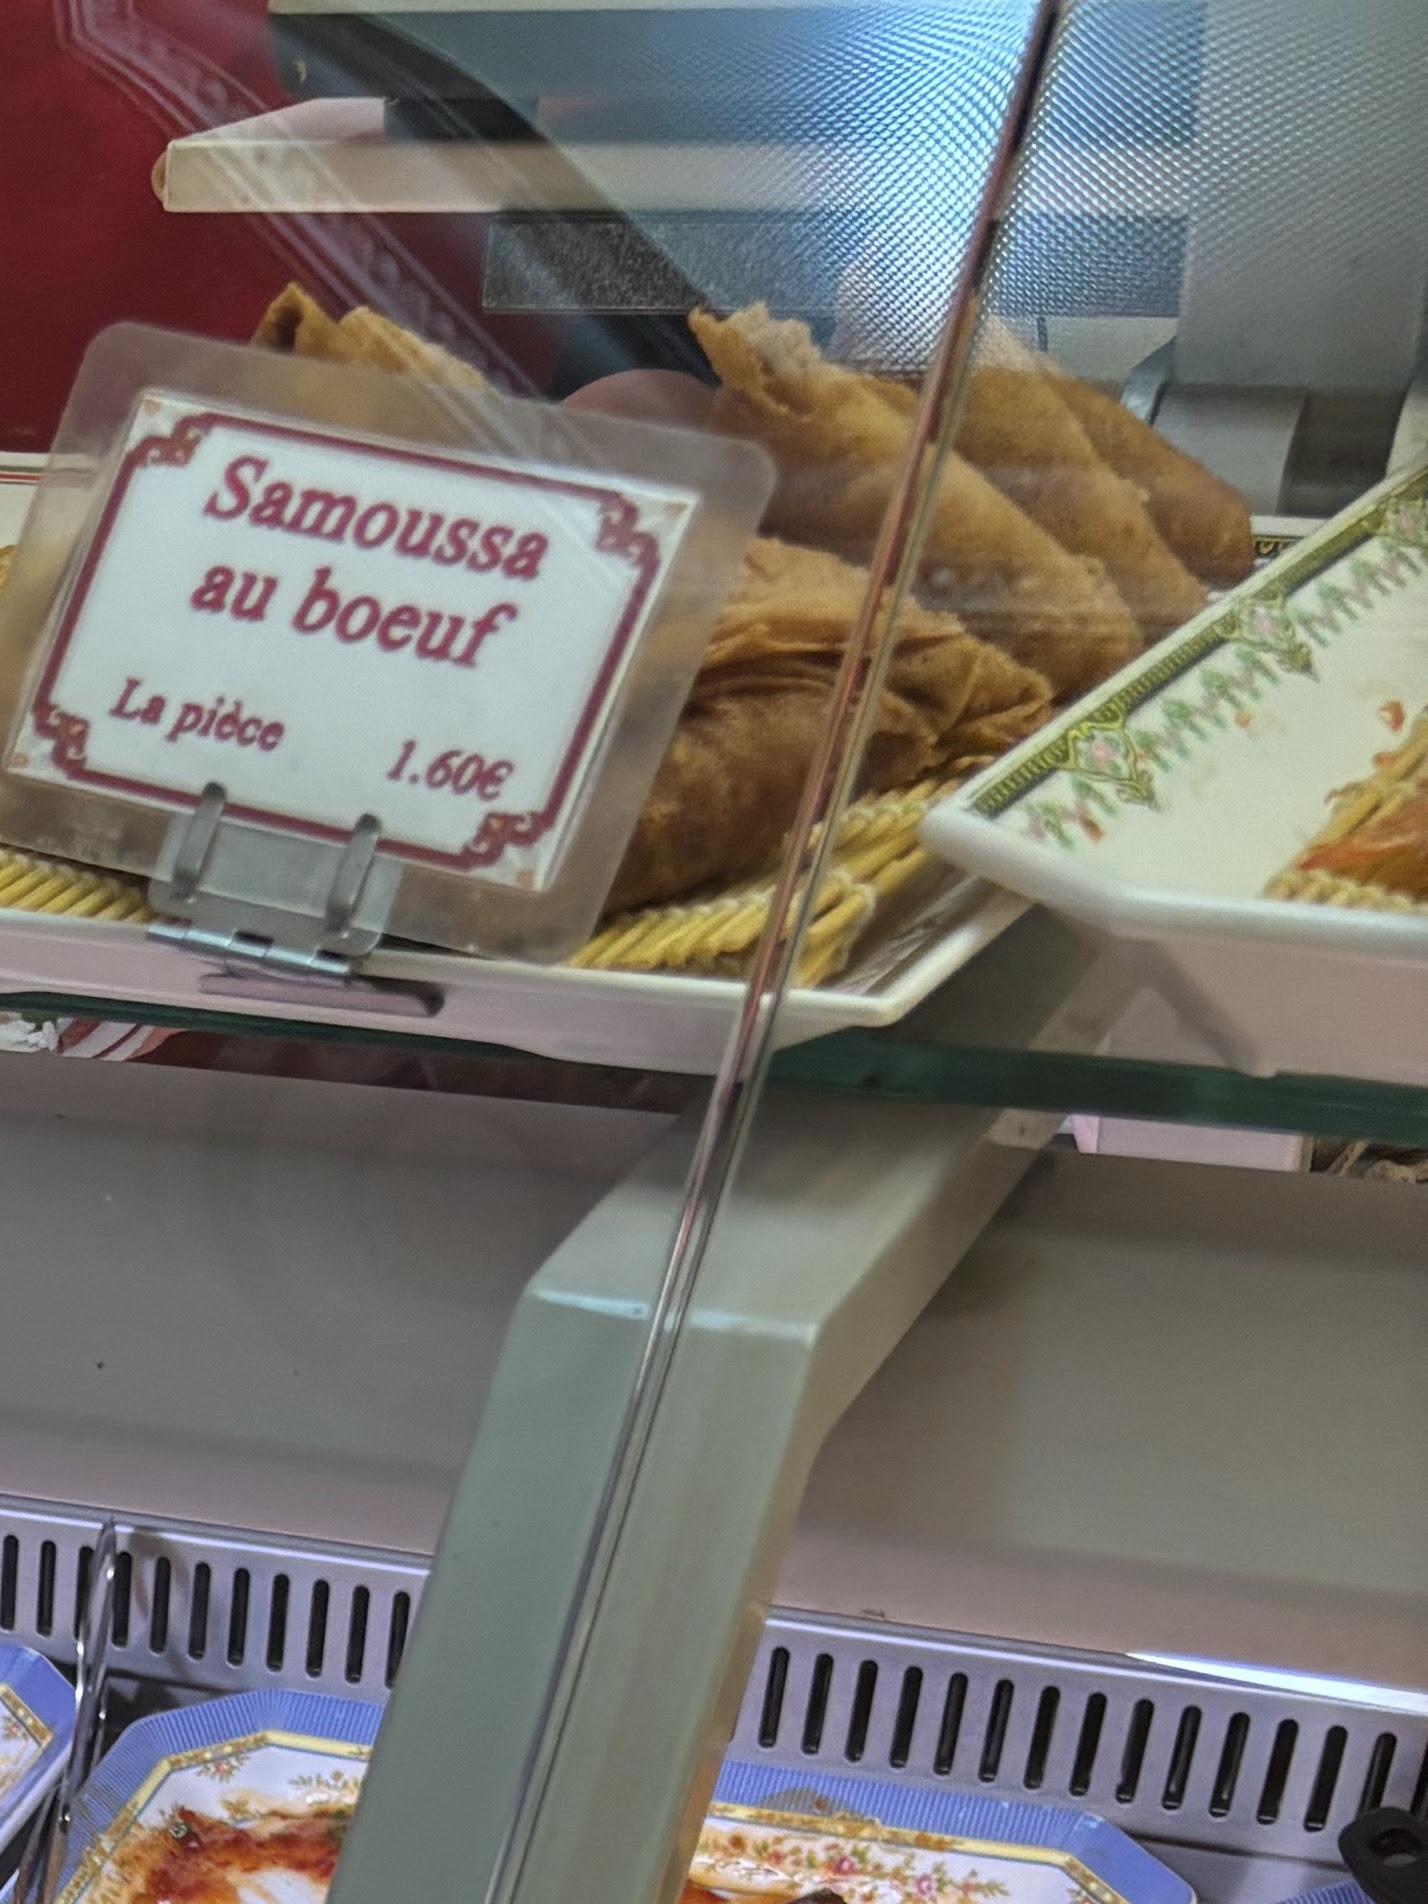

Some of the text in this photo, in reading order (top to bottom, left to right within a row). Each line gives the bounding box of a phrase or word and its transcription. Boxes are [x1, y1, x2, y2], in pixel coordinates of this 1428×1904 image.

[203, 453, 550, 583] Samoussa
[189, 562, 519, 671] au boeuf
[109, 678, 515, 801] La pièce 1.60€
